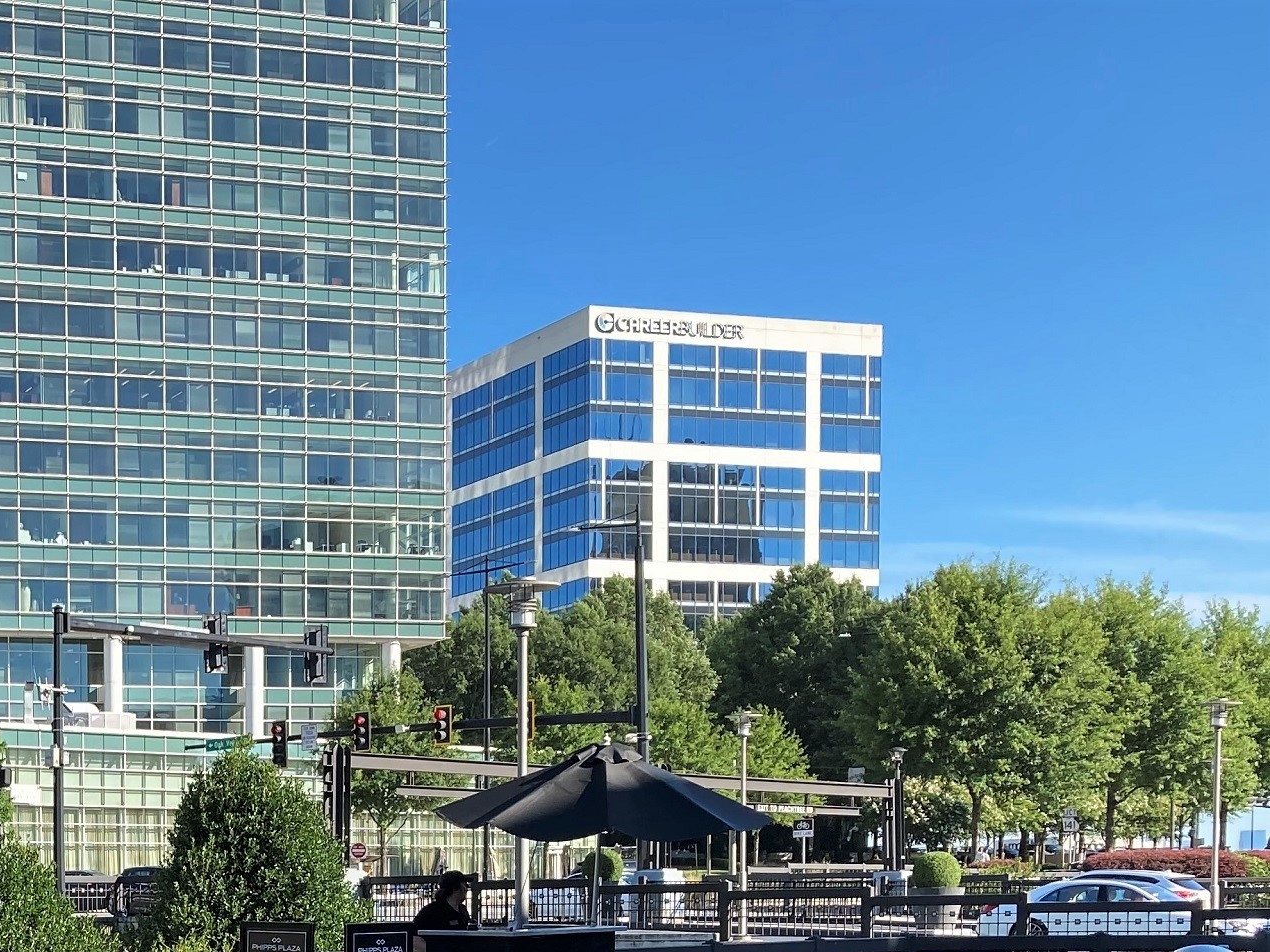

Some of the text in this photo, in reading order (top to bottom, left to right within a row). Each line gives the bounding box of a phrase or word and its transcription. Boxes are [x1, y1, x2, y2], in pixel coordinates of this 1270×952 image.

[615, 316, 744, 340] CAREERBUILDER
[1064, 820, 1076, 830] 141
[251, 943, 301, 952] PHIPPS PLAZA
